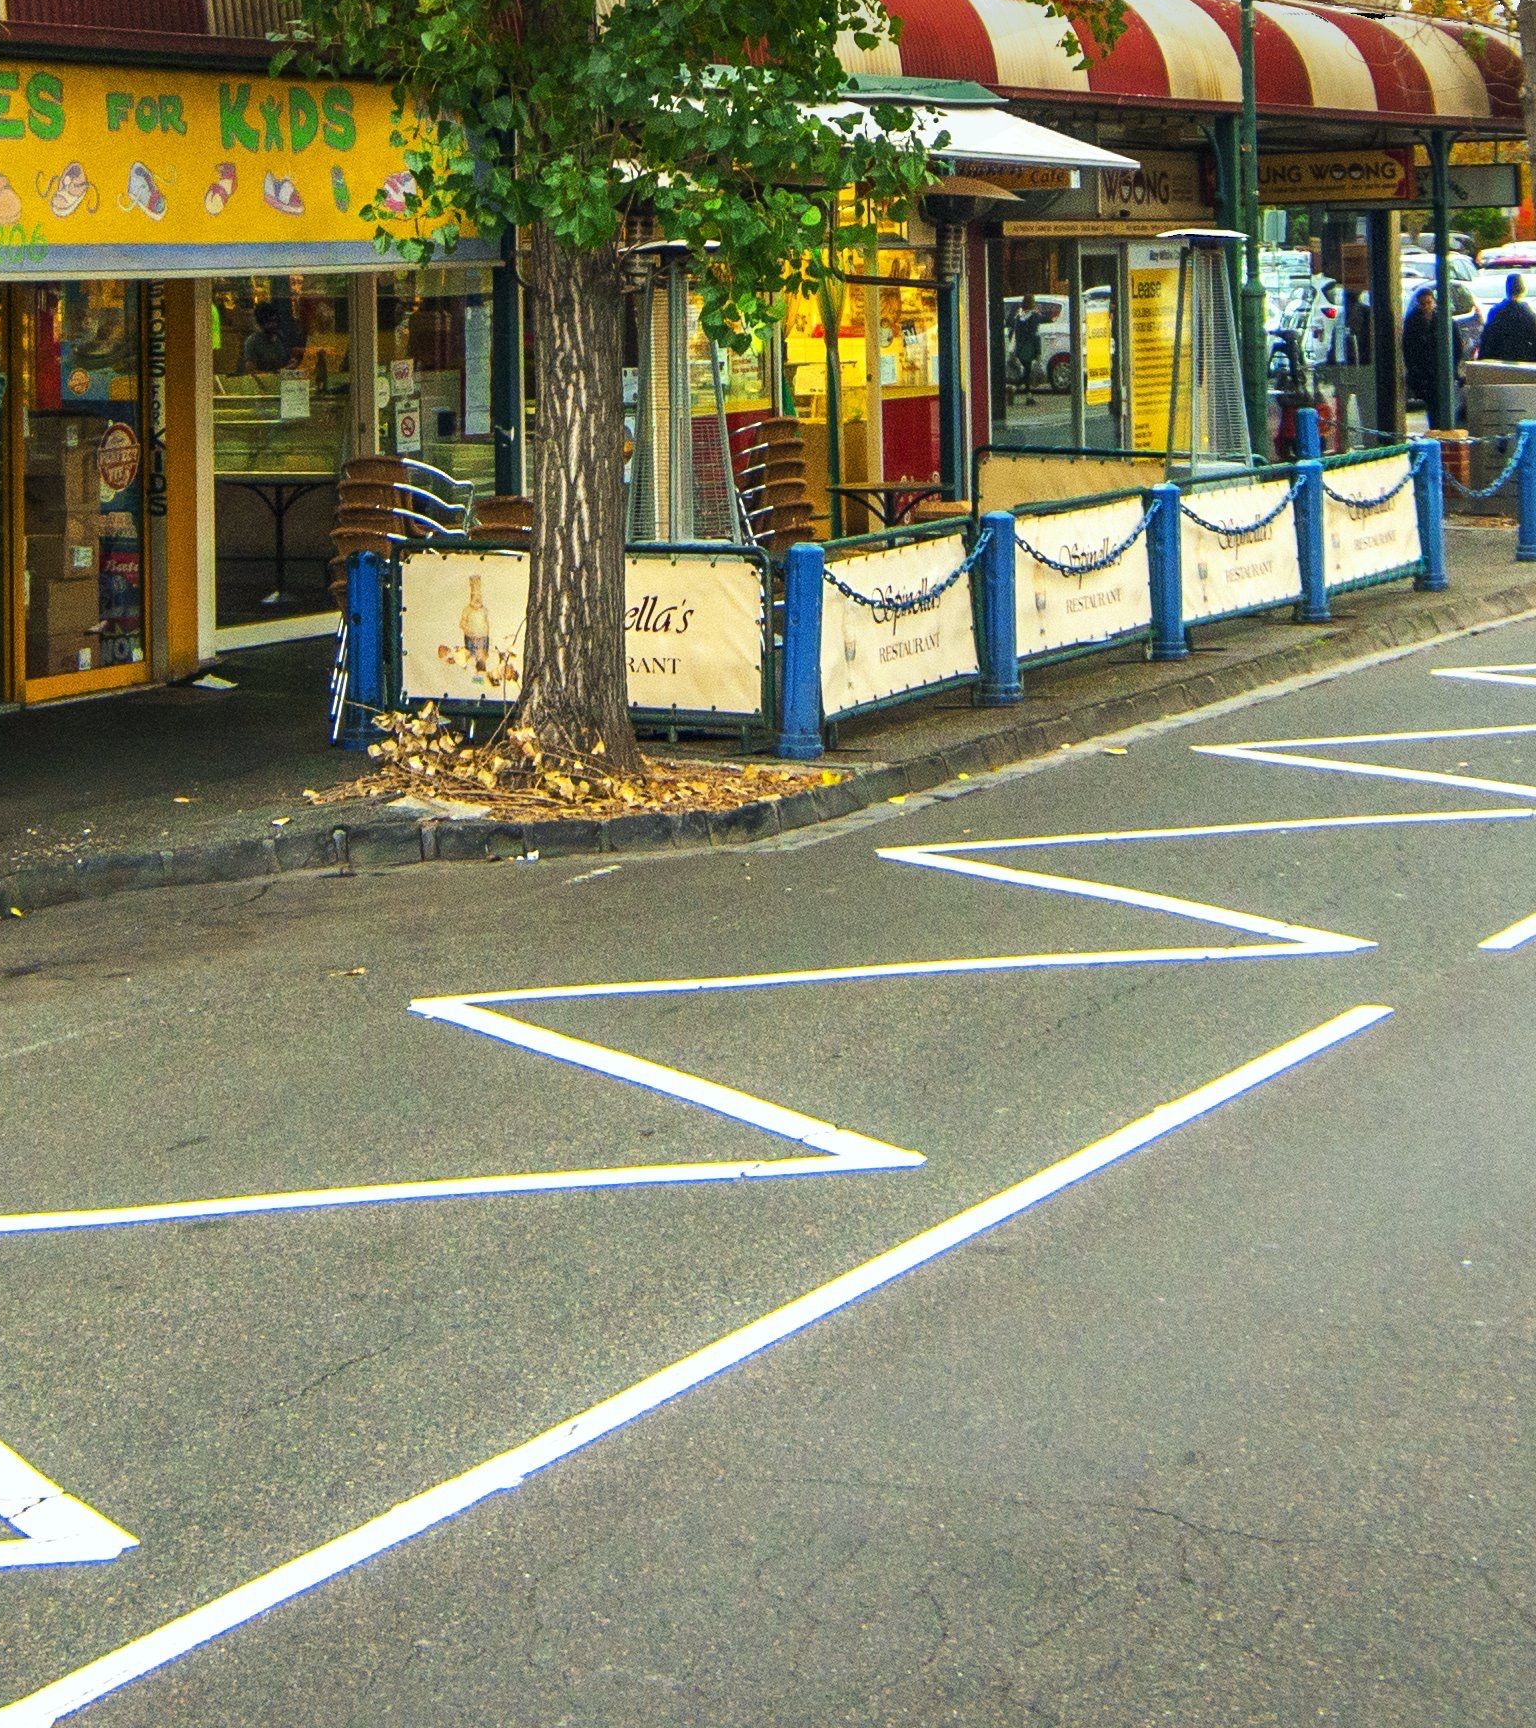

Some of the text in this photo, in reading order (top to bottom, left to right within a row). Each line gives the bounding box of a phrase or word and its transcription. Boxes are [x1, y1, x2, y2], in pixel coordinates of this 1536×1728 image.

[106, 91, 188, 135] FOR
[220, 82, 357, 153] KIDS
[1309, 161, 1396, 180] WOONG
[624, 595, 695, 634] ella's
[1066, 587, 1122, 614] RESTAURANT
[879, 632, 941, 664] RESTAURANT
